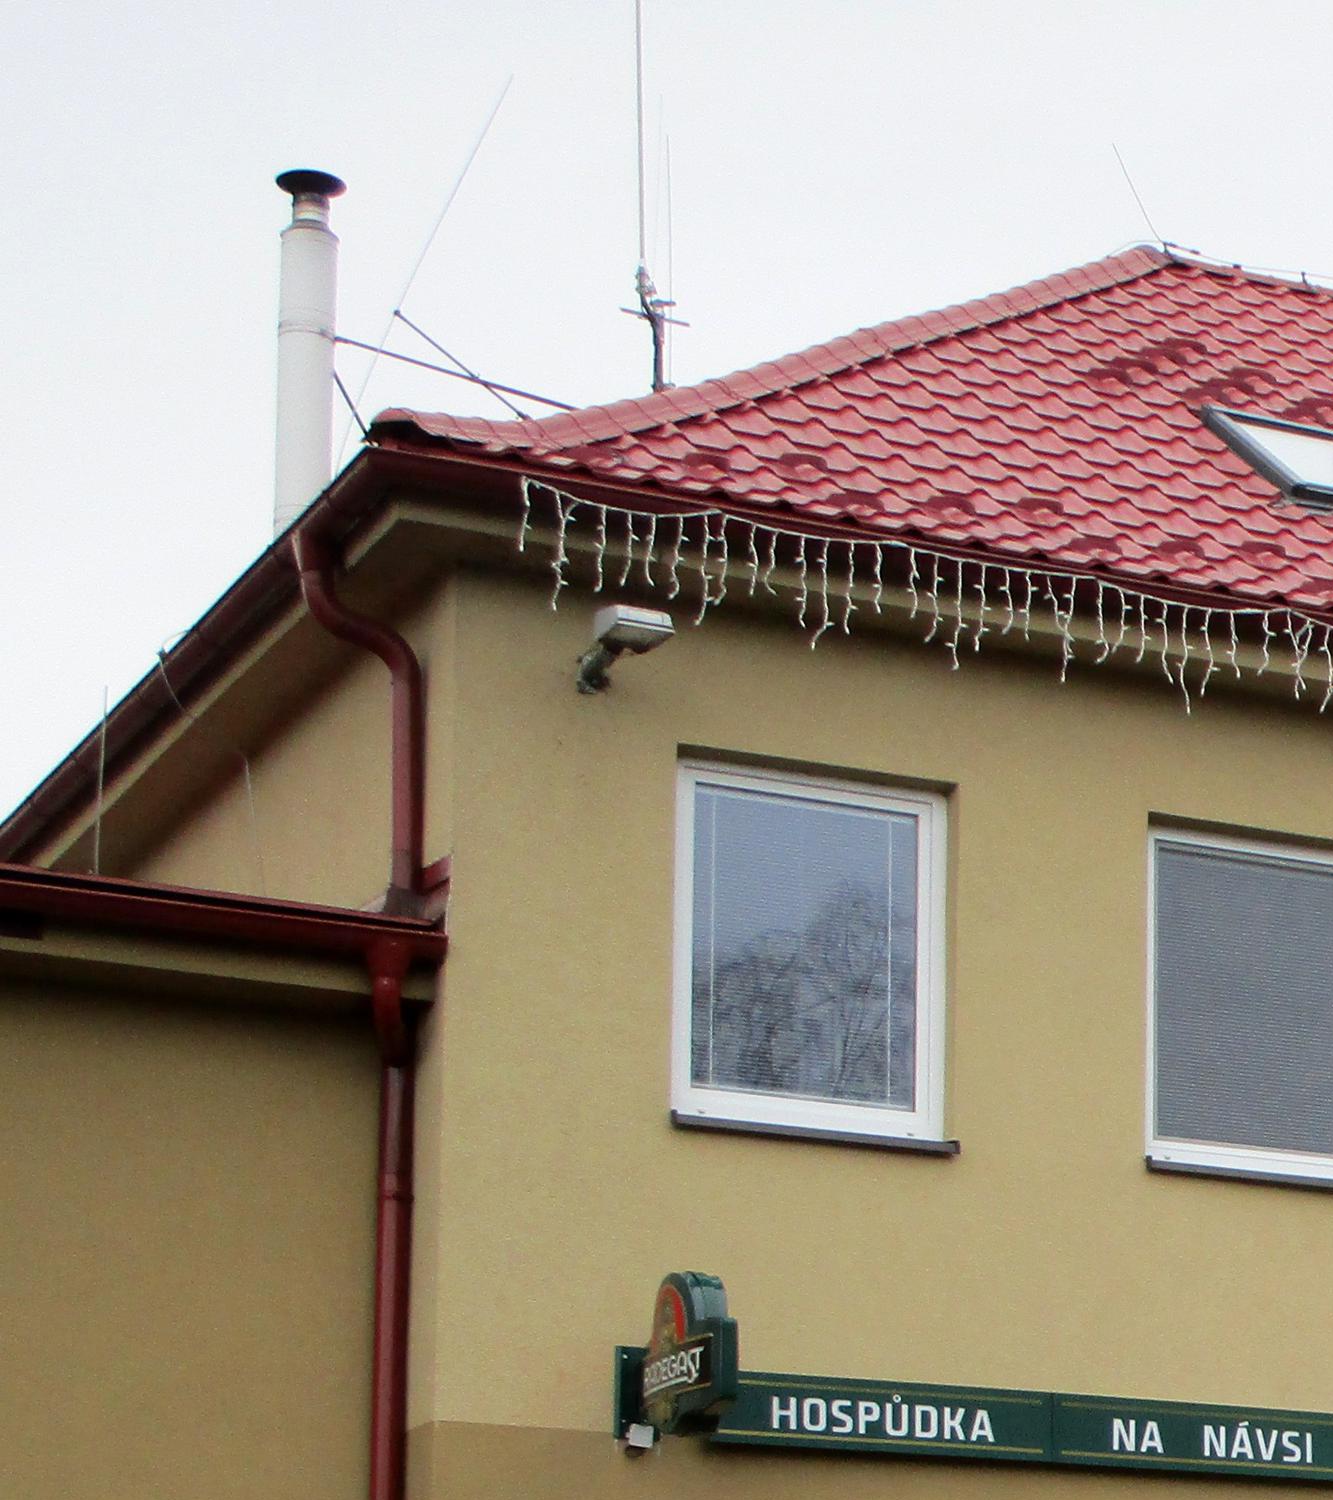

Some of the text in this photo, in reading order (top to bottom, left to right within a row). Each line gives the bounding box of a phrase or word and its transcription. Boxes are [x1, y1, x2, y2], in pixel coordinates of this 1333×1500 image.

[771, 1394, 1313, 1463] HOSPŮDKA NA NÁVSI
